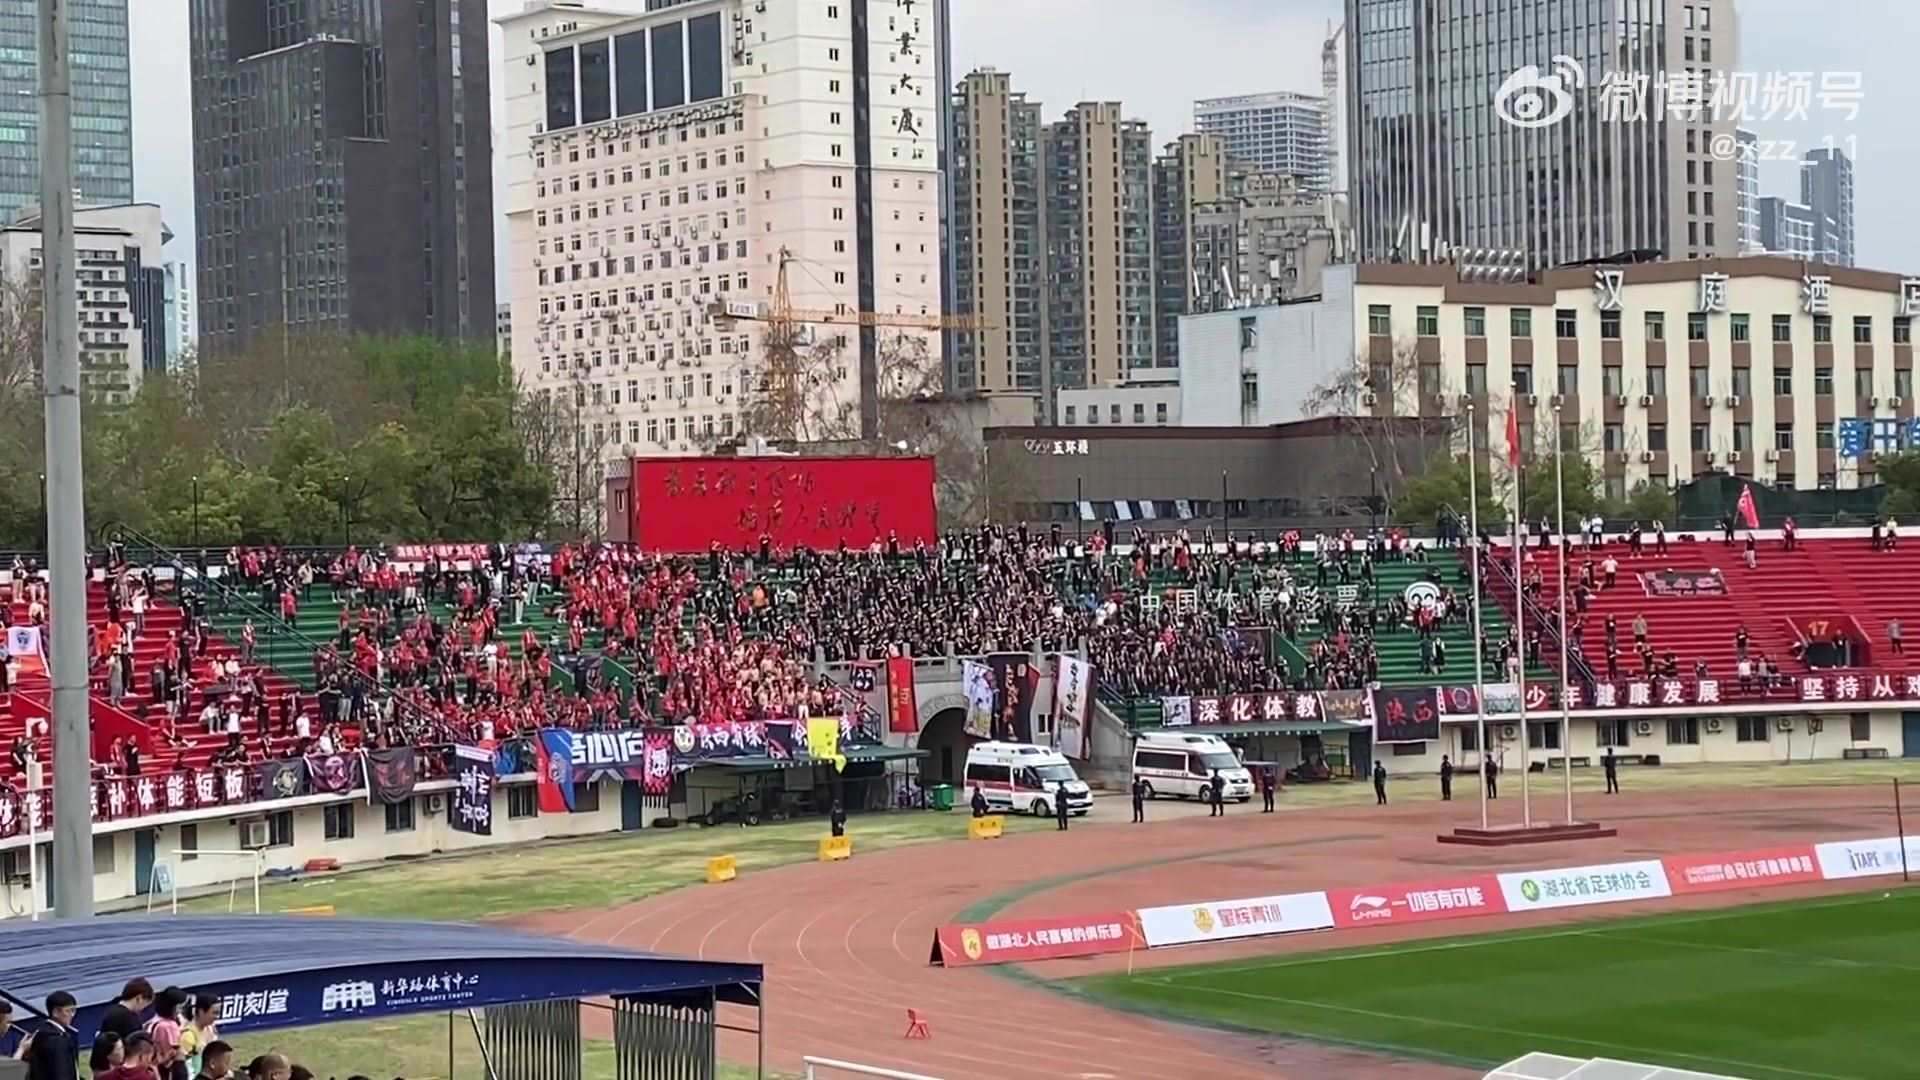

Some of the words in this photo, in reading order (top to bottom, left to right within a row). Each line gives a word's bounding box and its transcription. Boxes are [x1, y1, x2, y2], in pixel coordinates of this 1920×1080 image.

[1808, 621, 1829, 636] 17
[1386, 698, 1433, 726] 陕西
[1543, 870, 1650, 898] 湖北省足球协会
[1391, 886, 1486, 913] 一切皆有可能
[380, 971, 480, 998] 新华路体育中心
